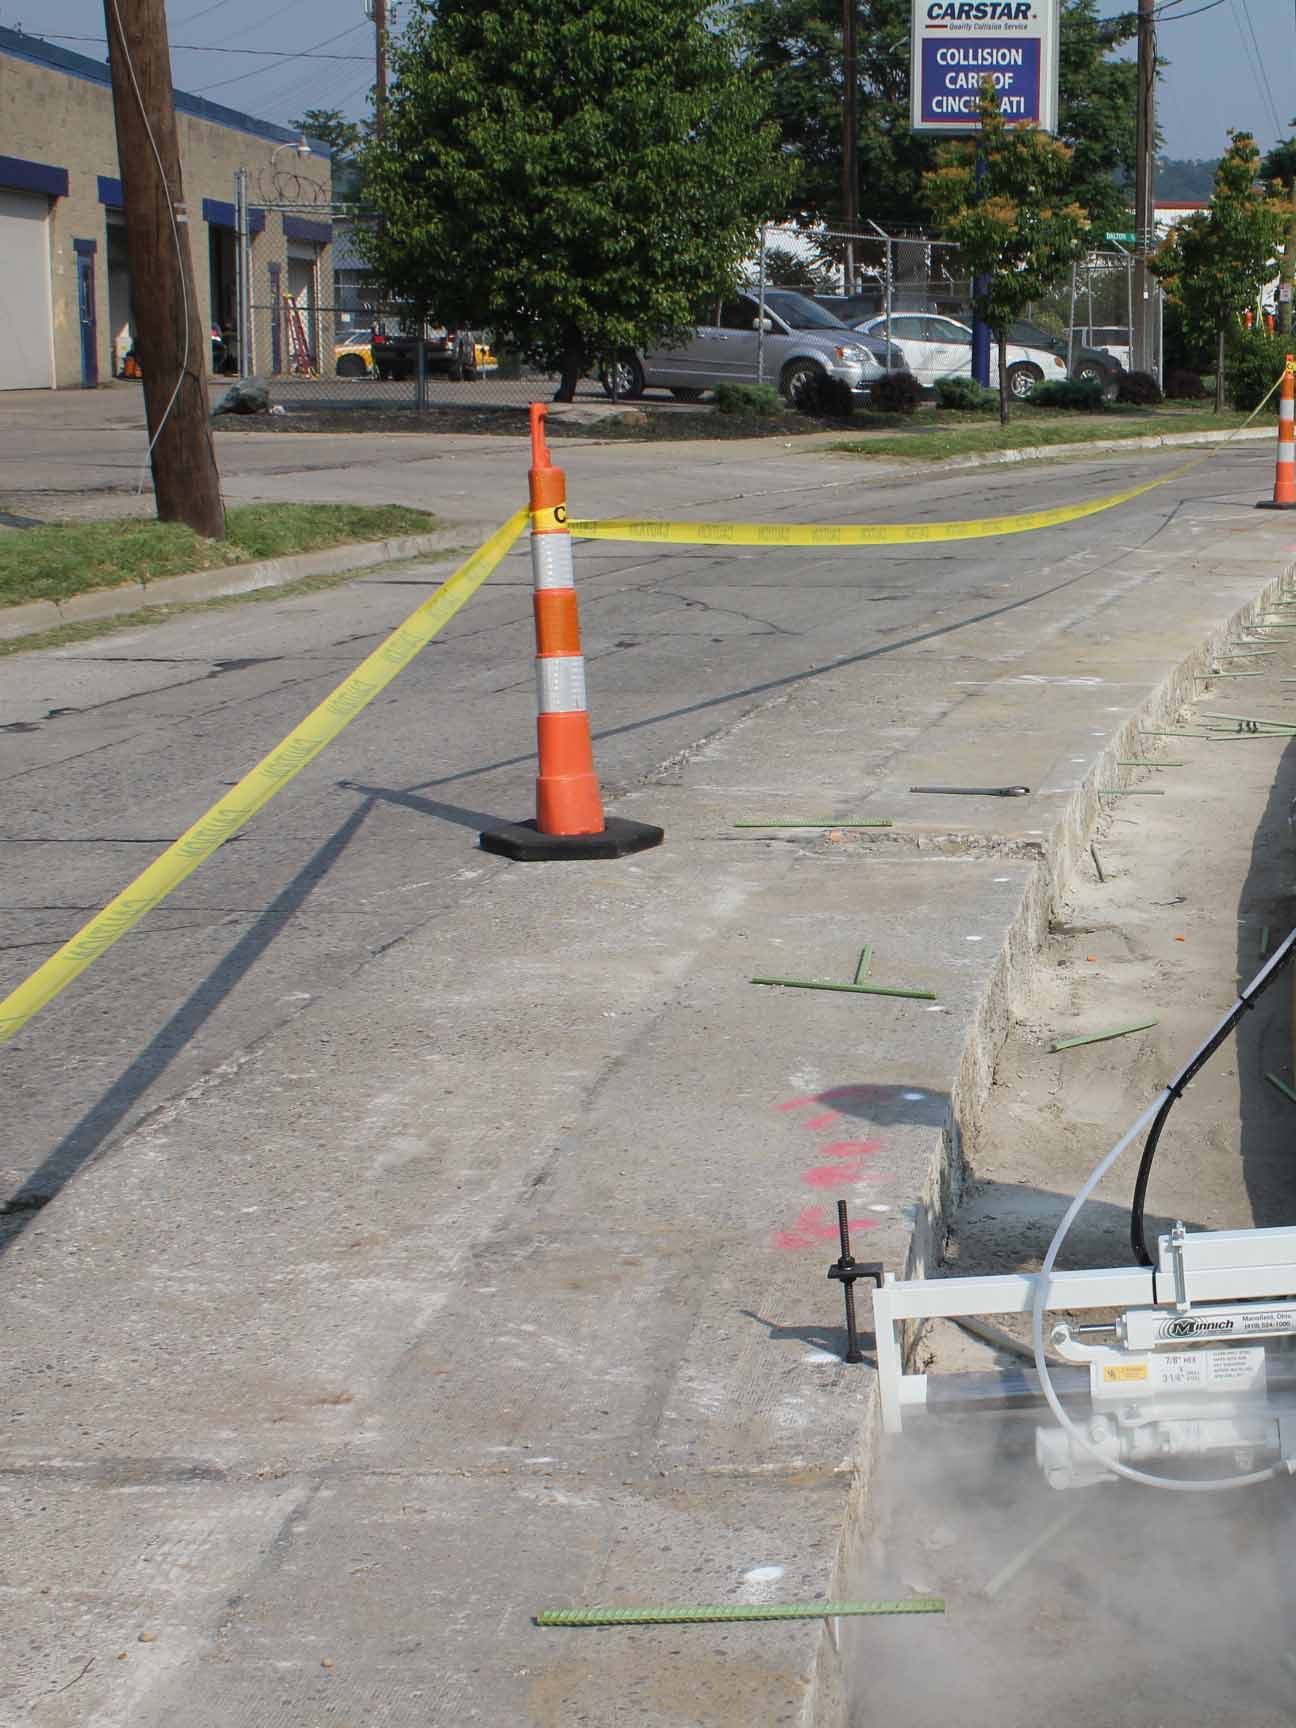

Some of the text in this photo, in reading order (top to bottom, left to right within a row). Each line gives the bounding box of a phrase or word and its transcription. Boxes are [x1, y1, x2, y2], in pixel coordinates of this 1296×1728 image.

[927, 2, 1031, 20] CARSTAR
[949, 22, 1027, 31] Quality Collision Service
[937, 48, 1023, 65] COLLISION
[991, 72, 1014, 89] OF
[932, 95, 1025, 113] CINCIATI
[1172, 1319, 1234, 1334] Minnich
